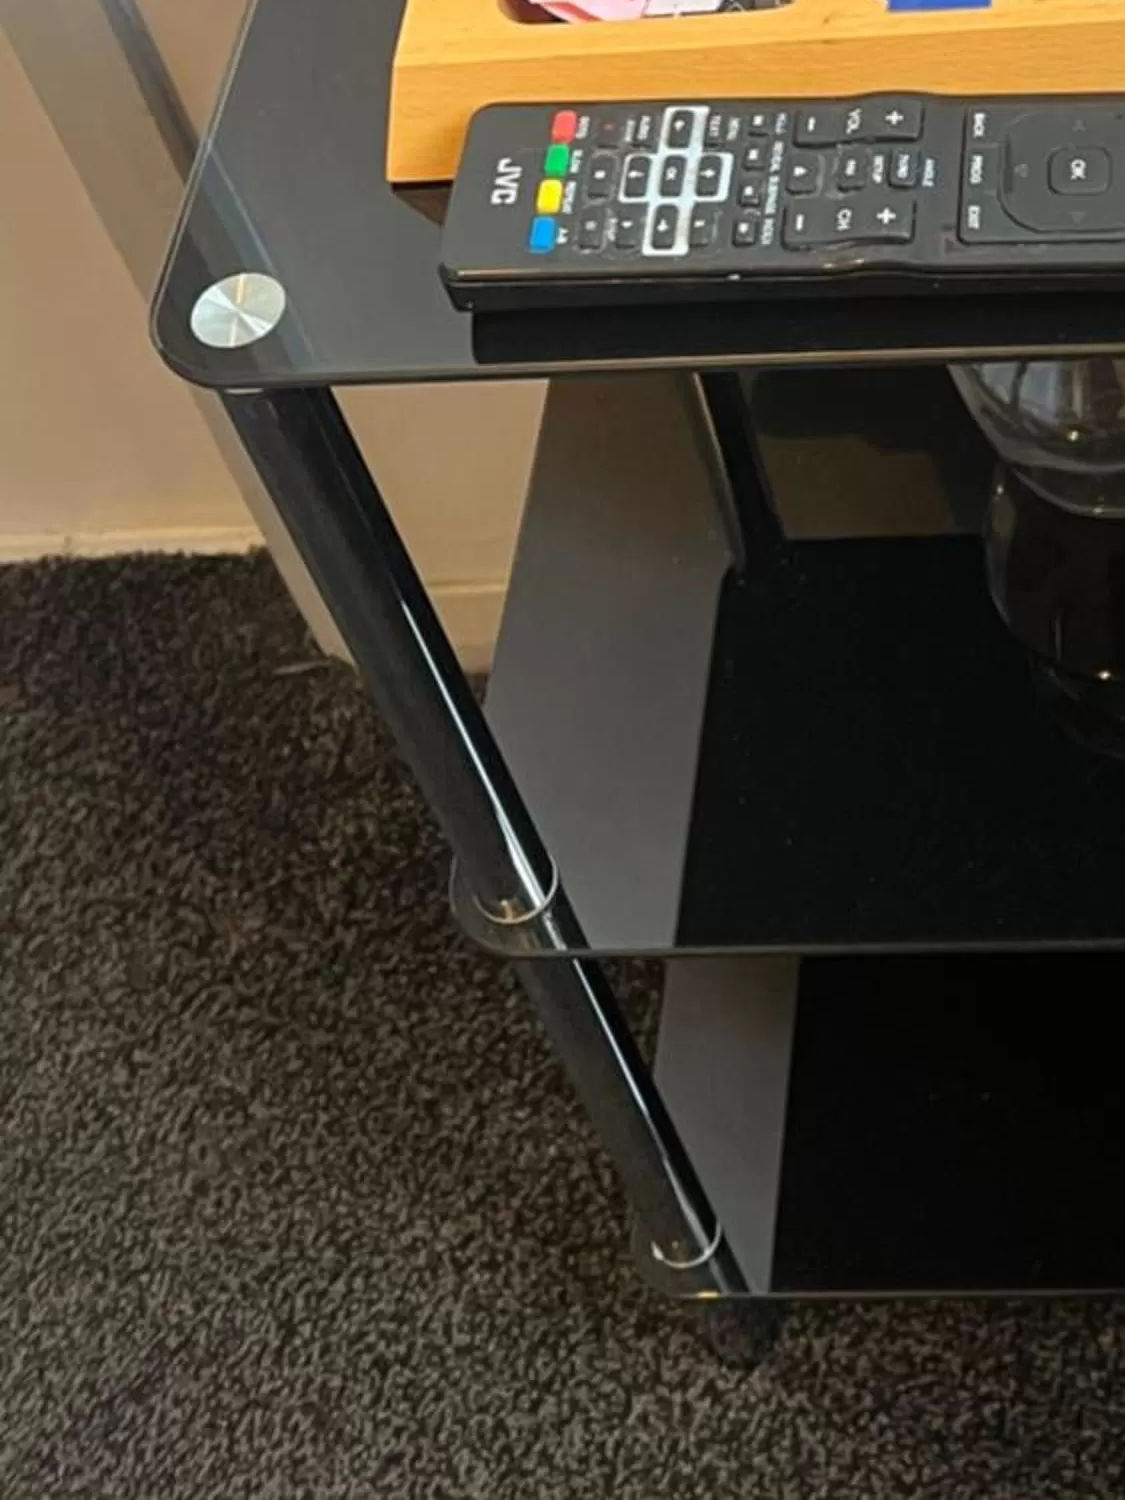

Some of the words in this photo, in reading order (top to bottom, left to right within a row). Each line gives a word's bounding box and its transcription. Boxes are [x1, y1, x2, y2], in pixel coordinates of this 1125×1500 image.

[845, 107, 862, 135] VOL
[490, 157, 523, 205] JVC
[1069, 158, 1088, 181] OK
[836, 208, 853, 231] CH
